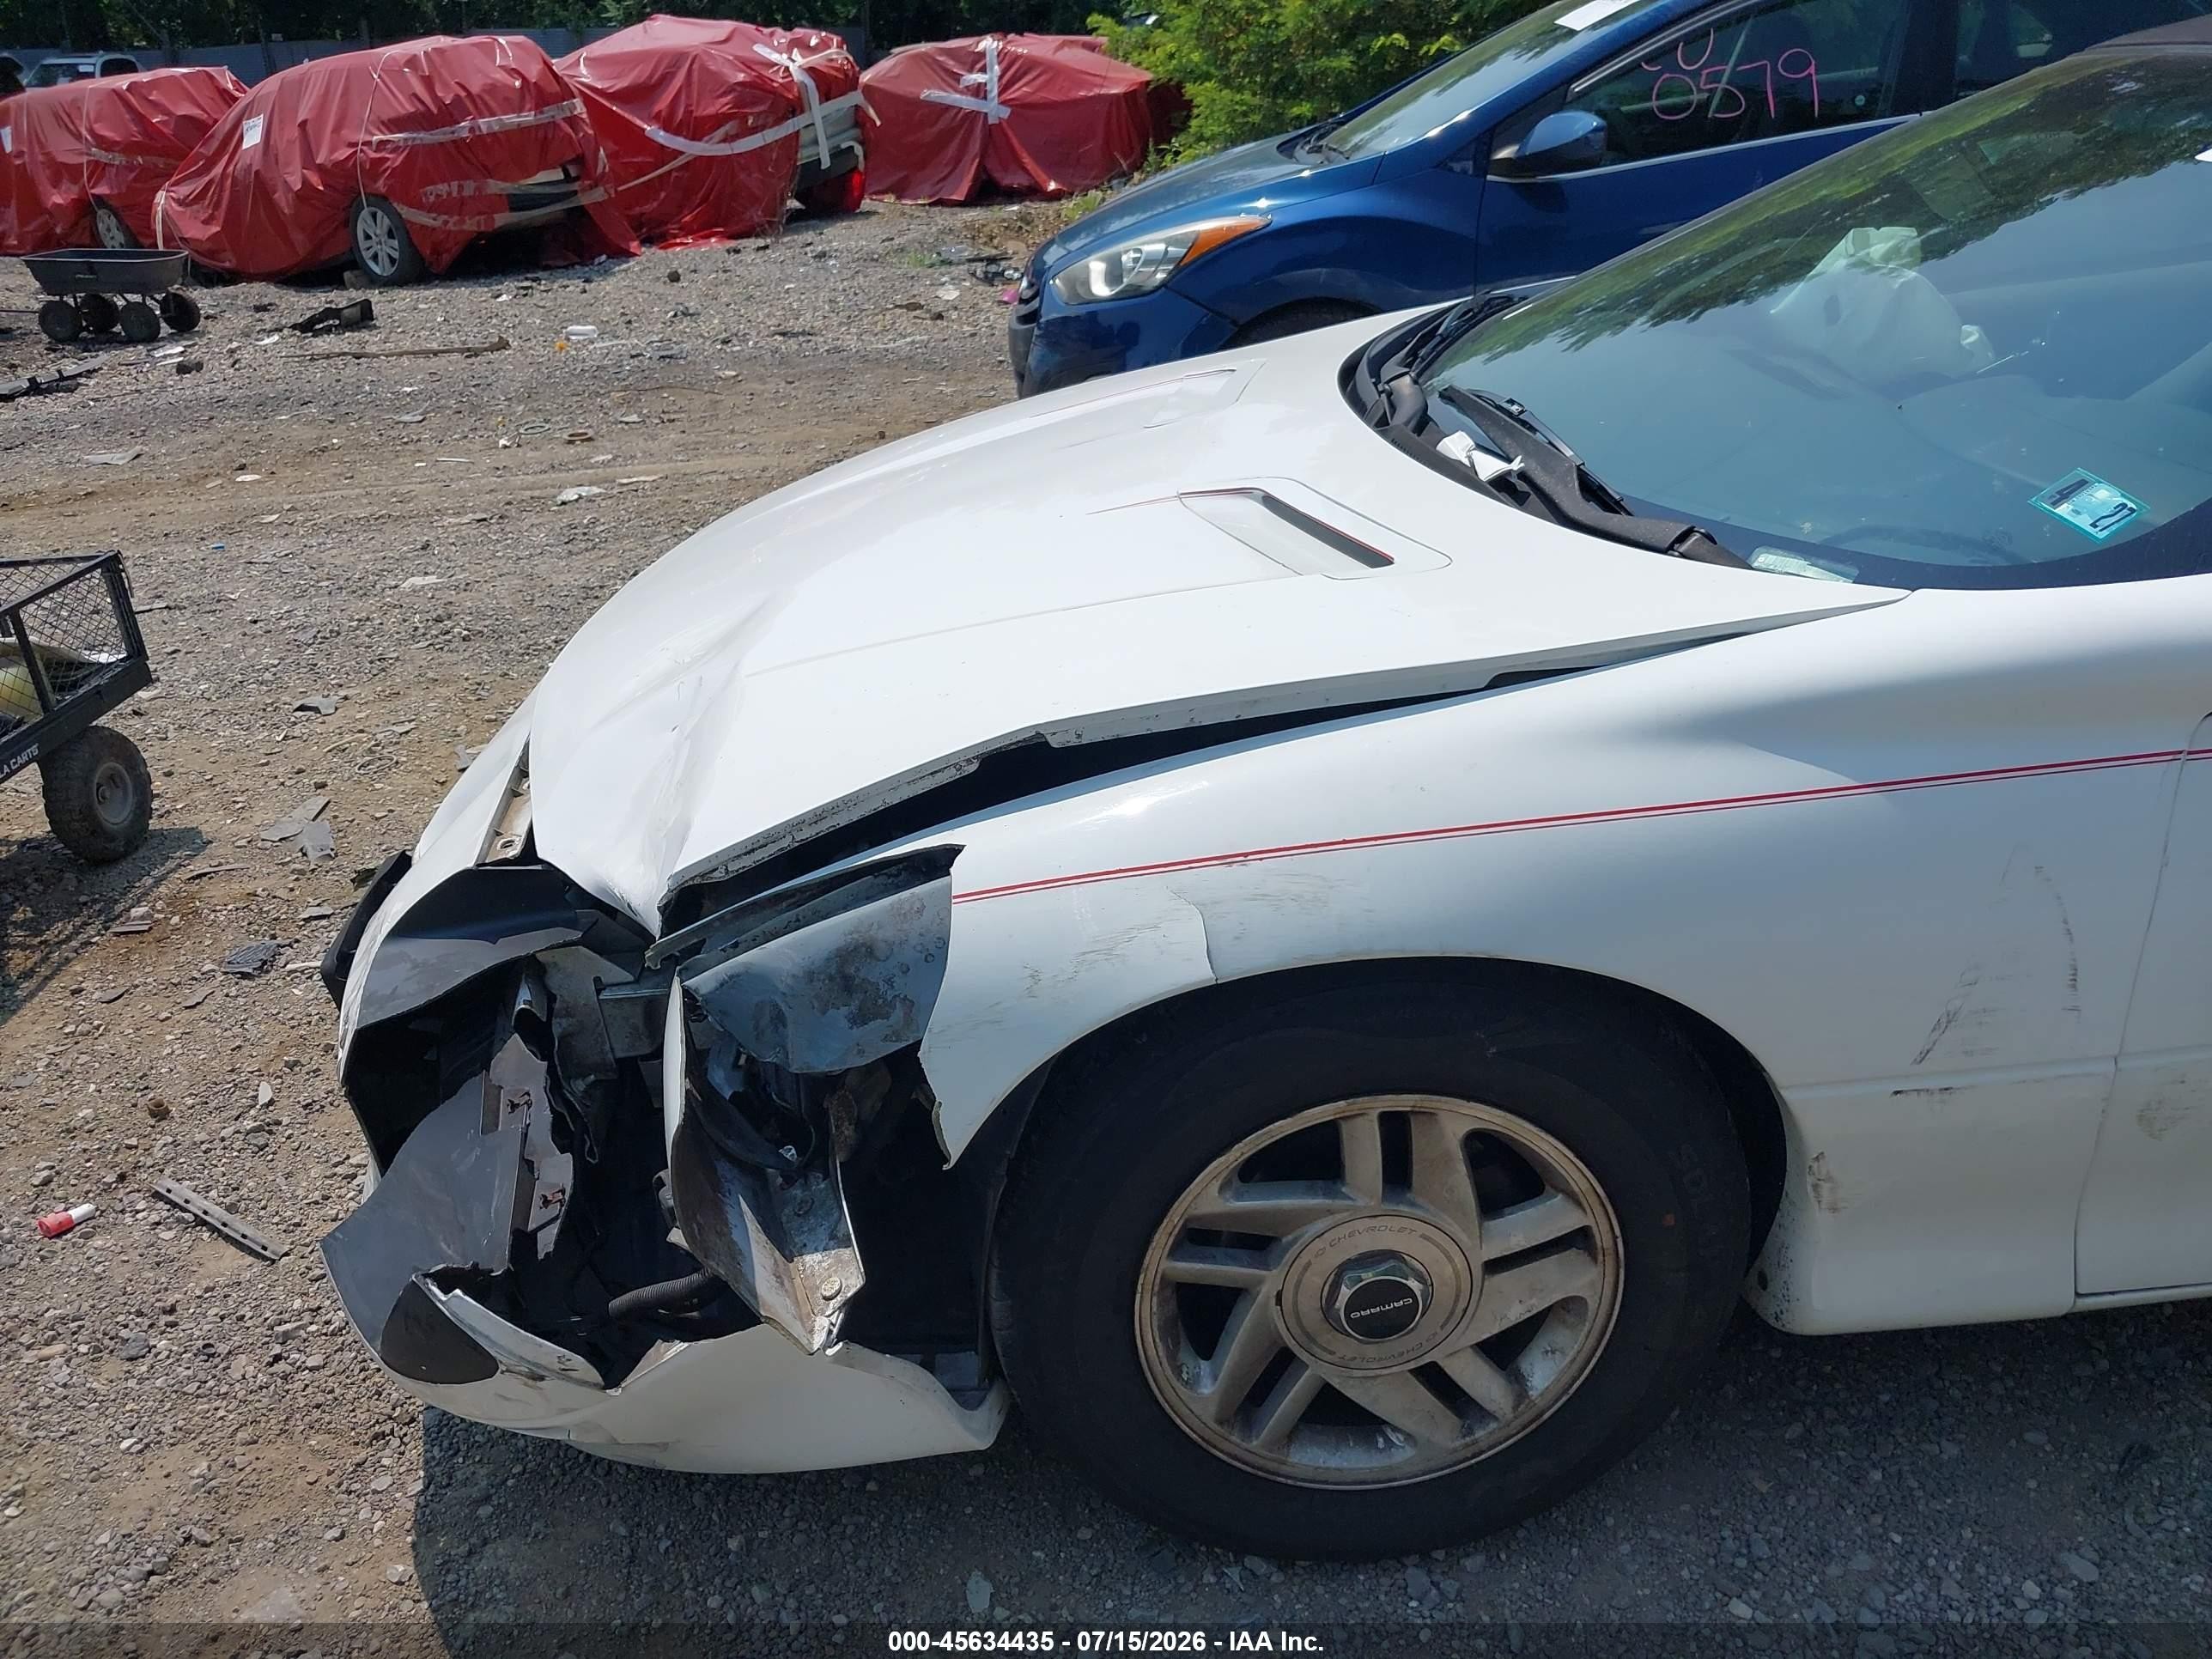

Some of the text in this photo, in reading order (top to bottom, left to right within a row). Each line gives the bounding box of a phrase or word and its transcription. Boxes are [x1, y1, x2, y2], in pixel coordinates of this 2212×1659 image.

[1652, 48, 1819, 120] 0579
[1329, 1224, 1418, 1248] CHEVROLET
[1350, 1297, 1413, 1319] CAMARO
